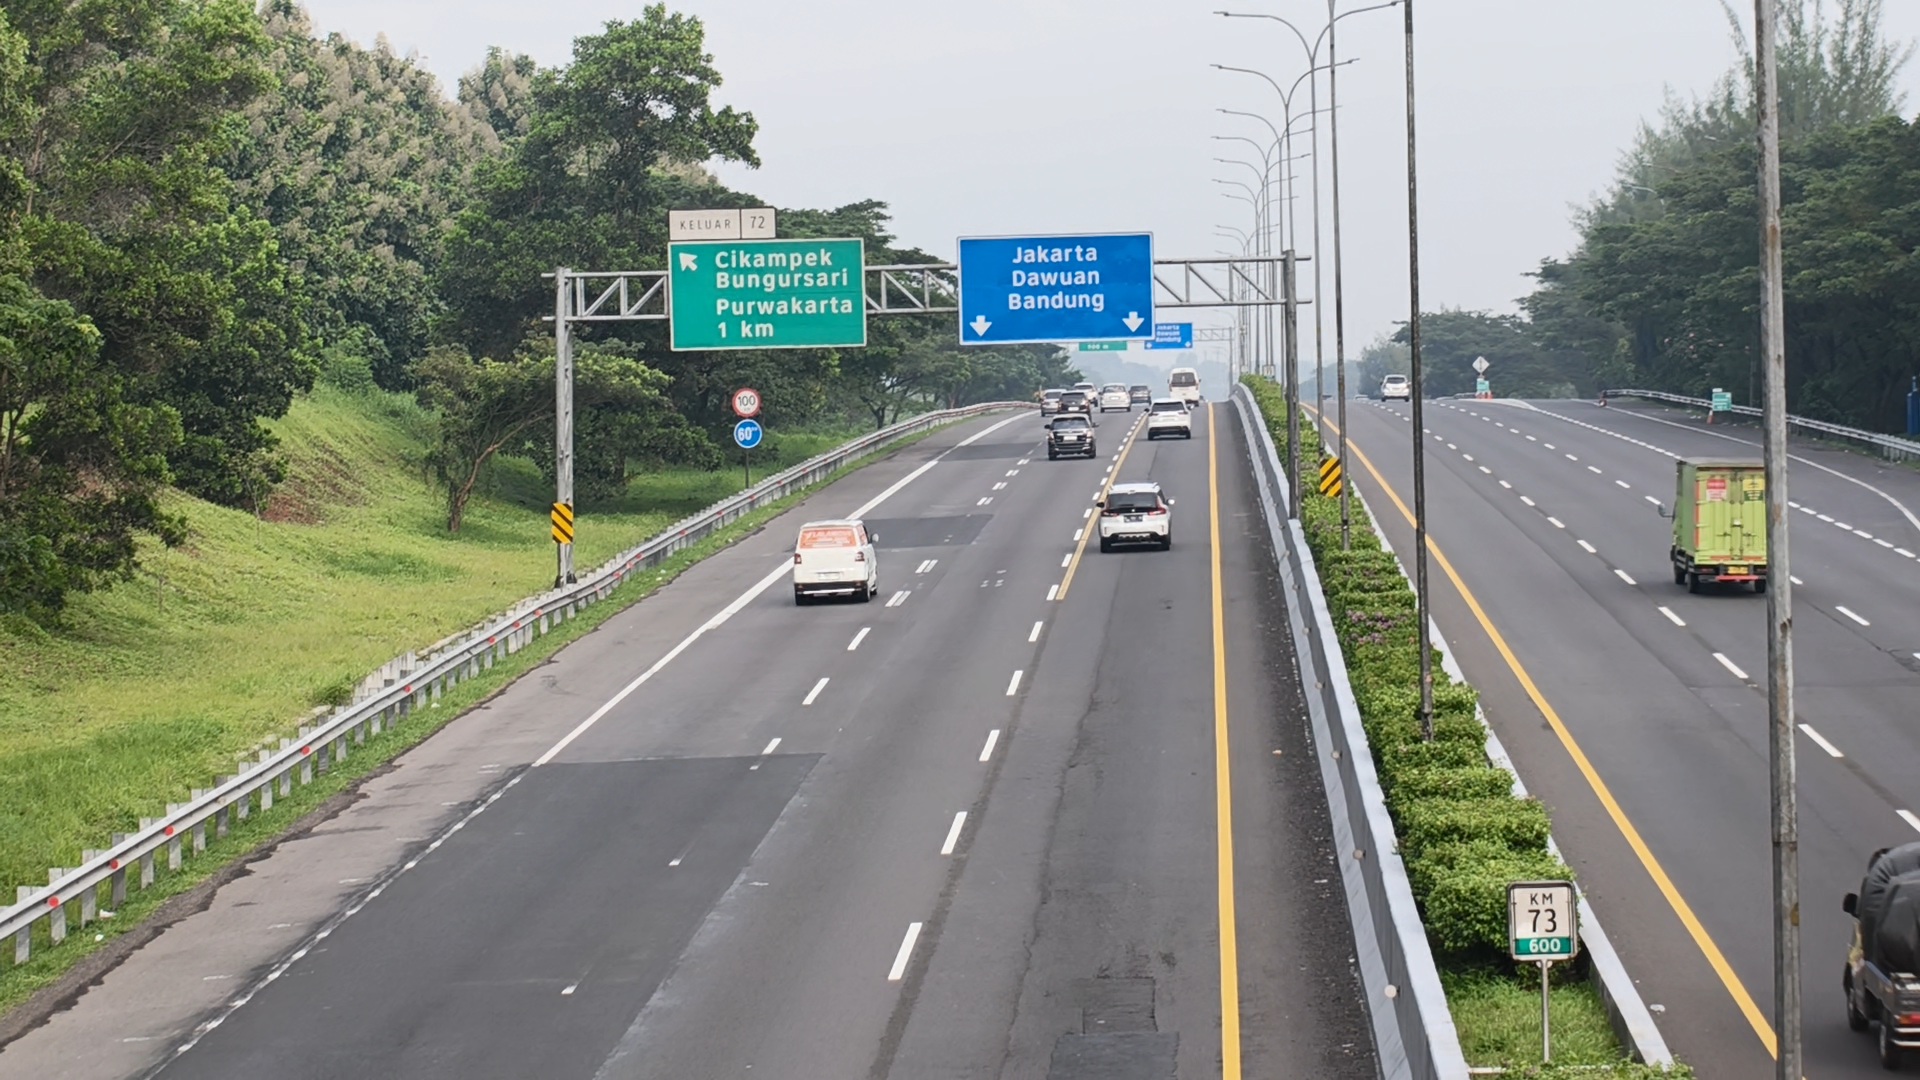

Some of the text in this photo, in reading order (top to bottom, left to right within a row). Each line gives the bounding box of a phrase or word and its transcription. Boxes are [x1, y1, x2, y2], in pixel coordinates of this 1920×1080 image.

[679, 215, 765, 231] KELUAR 72
[715, 248, 833, 271] Cikampek
[1012, 244, 1098, 264] Jakarta
[716, 267, 849, 292] Bungursari
[1011, 269, 1100, 287] Dawuan
[716, 296, 853, 316] Purwakarta
[1007, 290, 1105, 312] Bandung
[717, 320, 774, 338] 1 km
[738, 395, 755, 406] 100
[738, 427, 752, 441] 60
[1530, 893, 1553, 905] KM
[1528, 908, 1557, 932] 73
[1529, 938, 1560, 952] 600
